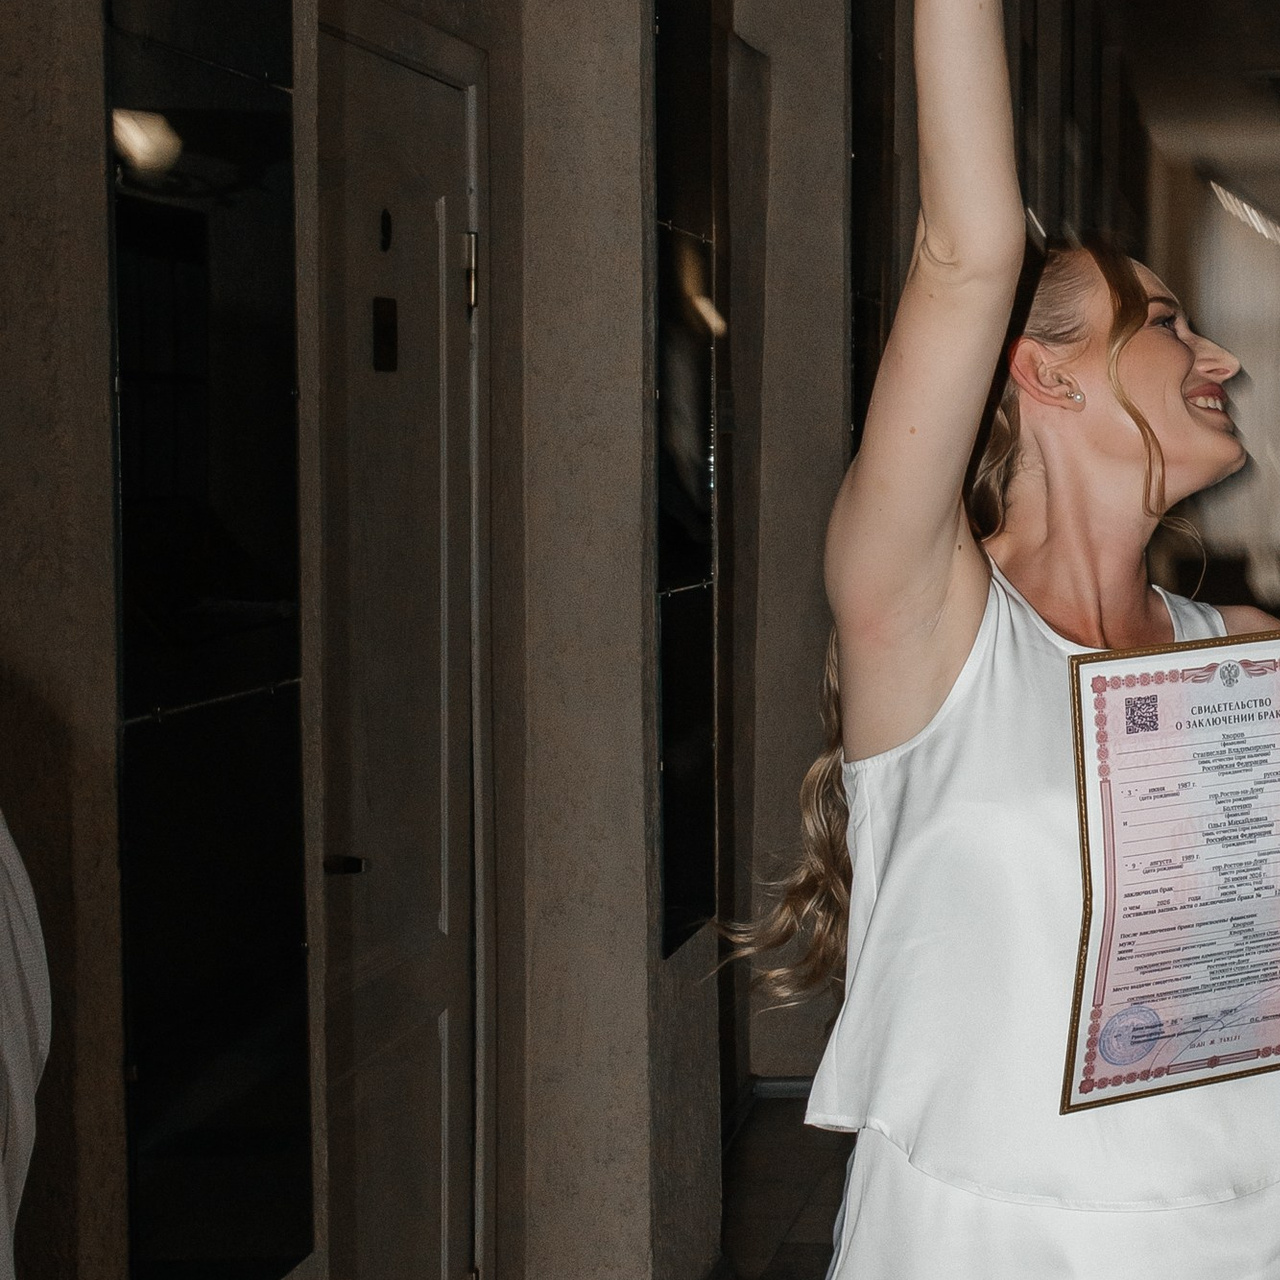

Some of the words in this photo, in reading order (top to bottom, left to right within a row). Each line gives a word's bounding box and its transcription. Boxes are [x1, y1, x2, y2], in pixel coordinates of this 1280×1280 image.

[1191, 698, 1271, 715] СВИДЕТЕЛЬСТВО
[1176, 722, 1182, 730] О
[1186, 714, 1254, 729] ЗАКЛЮЧЕНИИ
[1193, 748, 1226, 758] Станислав
[1202, 762, 1235, 772] Российская
[1236, 759, 1268, 768] Федерация
[1206, 834, 1239, 844] Российская
[1240, 829, 1272, 840] Федерация
[1150, 858, 1172, 867] августа
